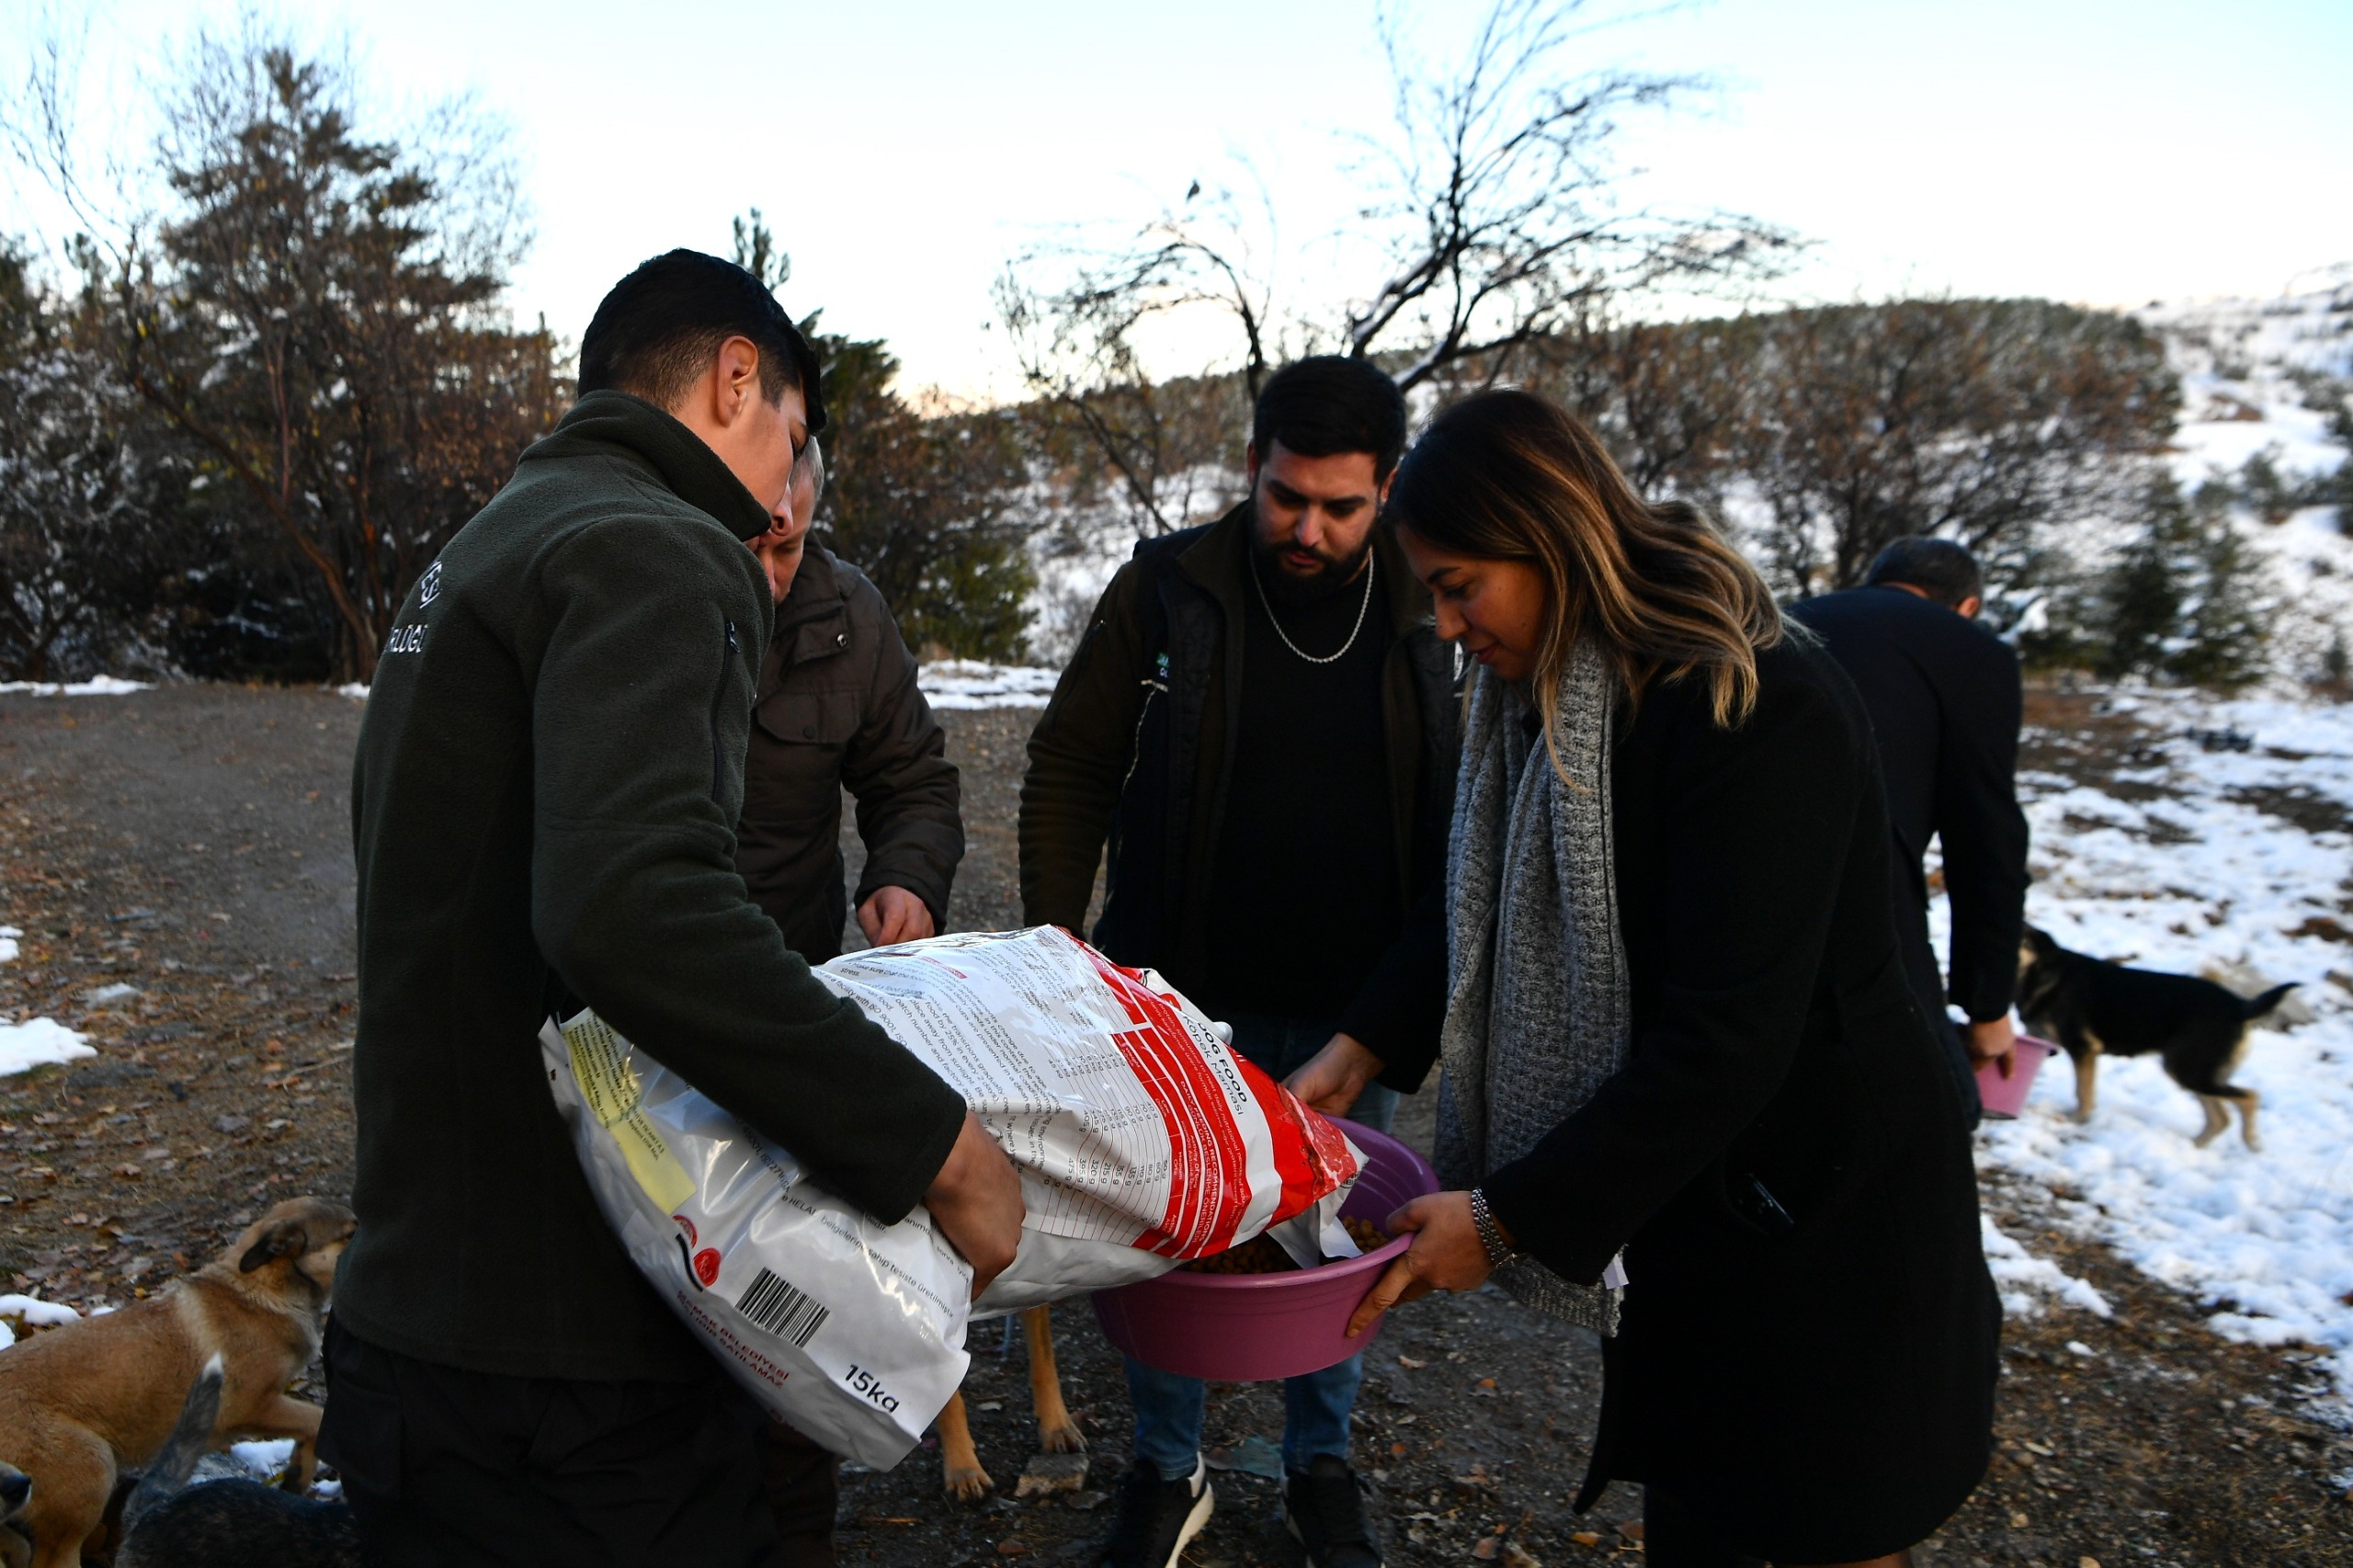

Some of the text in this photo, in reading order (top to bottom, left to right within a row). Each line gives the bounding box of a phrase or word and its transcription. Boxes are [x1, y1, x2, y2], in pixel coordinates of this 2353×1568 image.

[835, 981, 855, 997] facility
[855, 994, 870, 1006] with
[868, 1003, 881, 1014] ISO
[879, 1013, 897, 1033] 9001,
[894, 1032, 908, 1048] ISO
[925, 1001, 940, 1019] food
[937, 1018, 948, 1030] by
[953, 992, 969, 1006] daily
[969, 1007, 985, 1028] needs
[983, 1028, 1001, 1048] under
[1000, 1050, 1021, 1074] normal
[963, 985, 1037, 1074] requirements change due to
[868, 965, 884, 975] sure
[955, 1005, 969, 1021] cups
[968, 1021, 979, 1032] are
[976, 1033, 1006, 1068] presented
[1003, 1067, 1011, 1076] in
[1013, 1082, 1029, 1102] clean
[944, 1030, 958, 1046] 25%
[1182, 1016, 1212, 1059] Köpek
[910, 1018, 933, 1046] number
[930, 1049, 945, 1062] and
[941, 1062, 964, 1086] factory
[942, 1012, 953, 1024] the
[951, 1025, 979, 1062] transitions
[977, 1062, 1003, 1095] gradually
[955, 1046, 964, 1055] in
[1176, 1028, 1201, 1064] formulated
[924, 1018, 940, 1038] away
[938, 1039, 952, 1057] from
[974, 1086, 984, 1097] Be
[959, 1050, 979, 1074] every
[983, 1017, 992, 1026] In
[990, 1025, 1001, 1039] this
[1022, 1067, 1033, 1080] the
[1031, 1079, 1053, 1115] recomm
[1078, 1055, 1093, 1074] 10 kg
[1104, 1061, 1112, 1070] kg
[1110, 1057, 1120, 1068] kg
[1047, 1058, 1063, 1079] 45 kg
[1063, 1068, 1071, 1077] kg
[1199, 1063, 1207, 1074] to
[1197, 1072, 1212, 1100] formüle
[1205, 1074, 1217, 1092] meet
[1219, 1059, 1247, 1102] FOOD
[1124, 1106, 1133, 1117] 90
[1132, 1105, 1141, 1115] 70
[1140, 1103, 1148, 1113] 70
[1146, 1101, 1155, 1112] 40
[1161, 1099, 1171, 1113] Low
[1209, 1094, 1223, 1112] daily
[1083, 1109, 1094, 1127] 405
[1117, 1108, 1125, 1119] 115
[1006, 1123, 1016, 1150] where
[1090, 1126, 1099, 1134] g
[1221, 1110, 1240, 1153] nutritional
[1029, 1141, 1036, 1149] in
[1187, 1102, 1205, 1144] GÜNLÜK
[1204, 1143, 1212, 1195] BESLENME
[1188, 1135, 1198, 1162] Activity
[1089, 1158, 1099, 1176] 320
[1101, 1161, 1112, 1176] 215
[1147, 1164, 1153, 1176] 80
[1155, 1162, 1161, 1174] 80
[1162, 1159, 1169, 1173] 50
[1180, 1079, 1219, 1243] DAILY FEEDING RECOMMENDATIONS
[1114, 1164, 1125, 1177] 155
[1127, 1165, 1137, 1179] 135
[821, 1216, 864, 1251] belgelerin
[868, 1248, 890, 1267] sahip
[890, 1264, 917, 1287] tesiste
